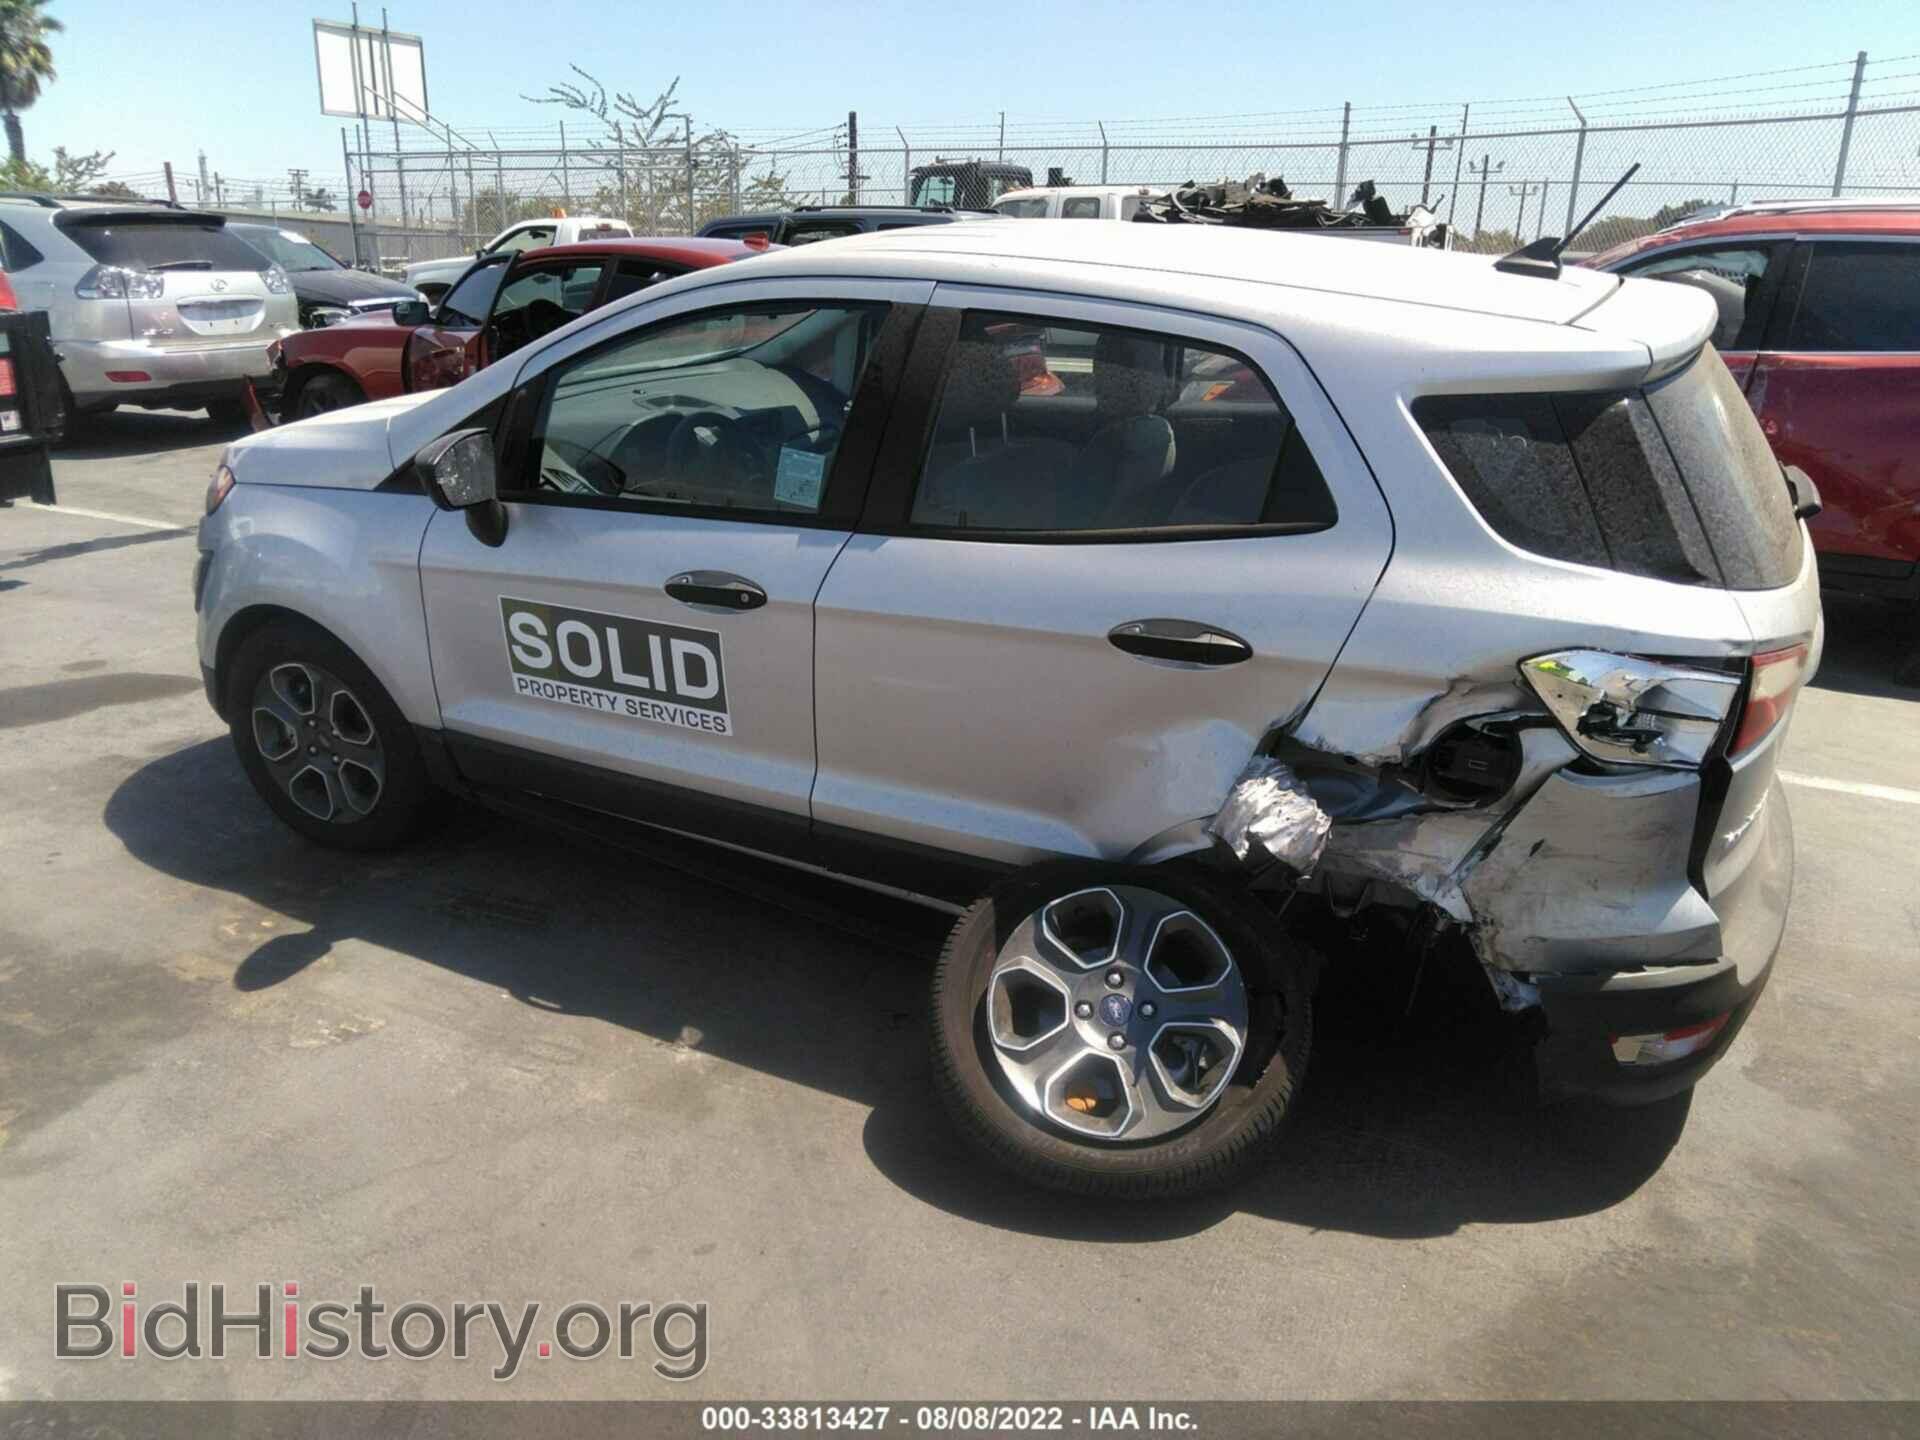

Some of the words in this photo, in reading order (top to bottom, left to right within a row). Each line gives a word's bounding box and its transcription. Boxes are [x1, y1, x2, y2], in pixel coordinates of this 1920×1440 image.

[509, 611, 720, 699] SOLID
[517, 678, 618, 711] PROPERTY
[625, 699, 727, 733] SERVICES
